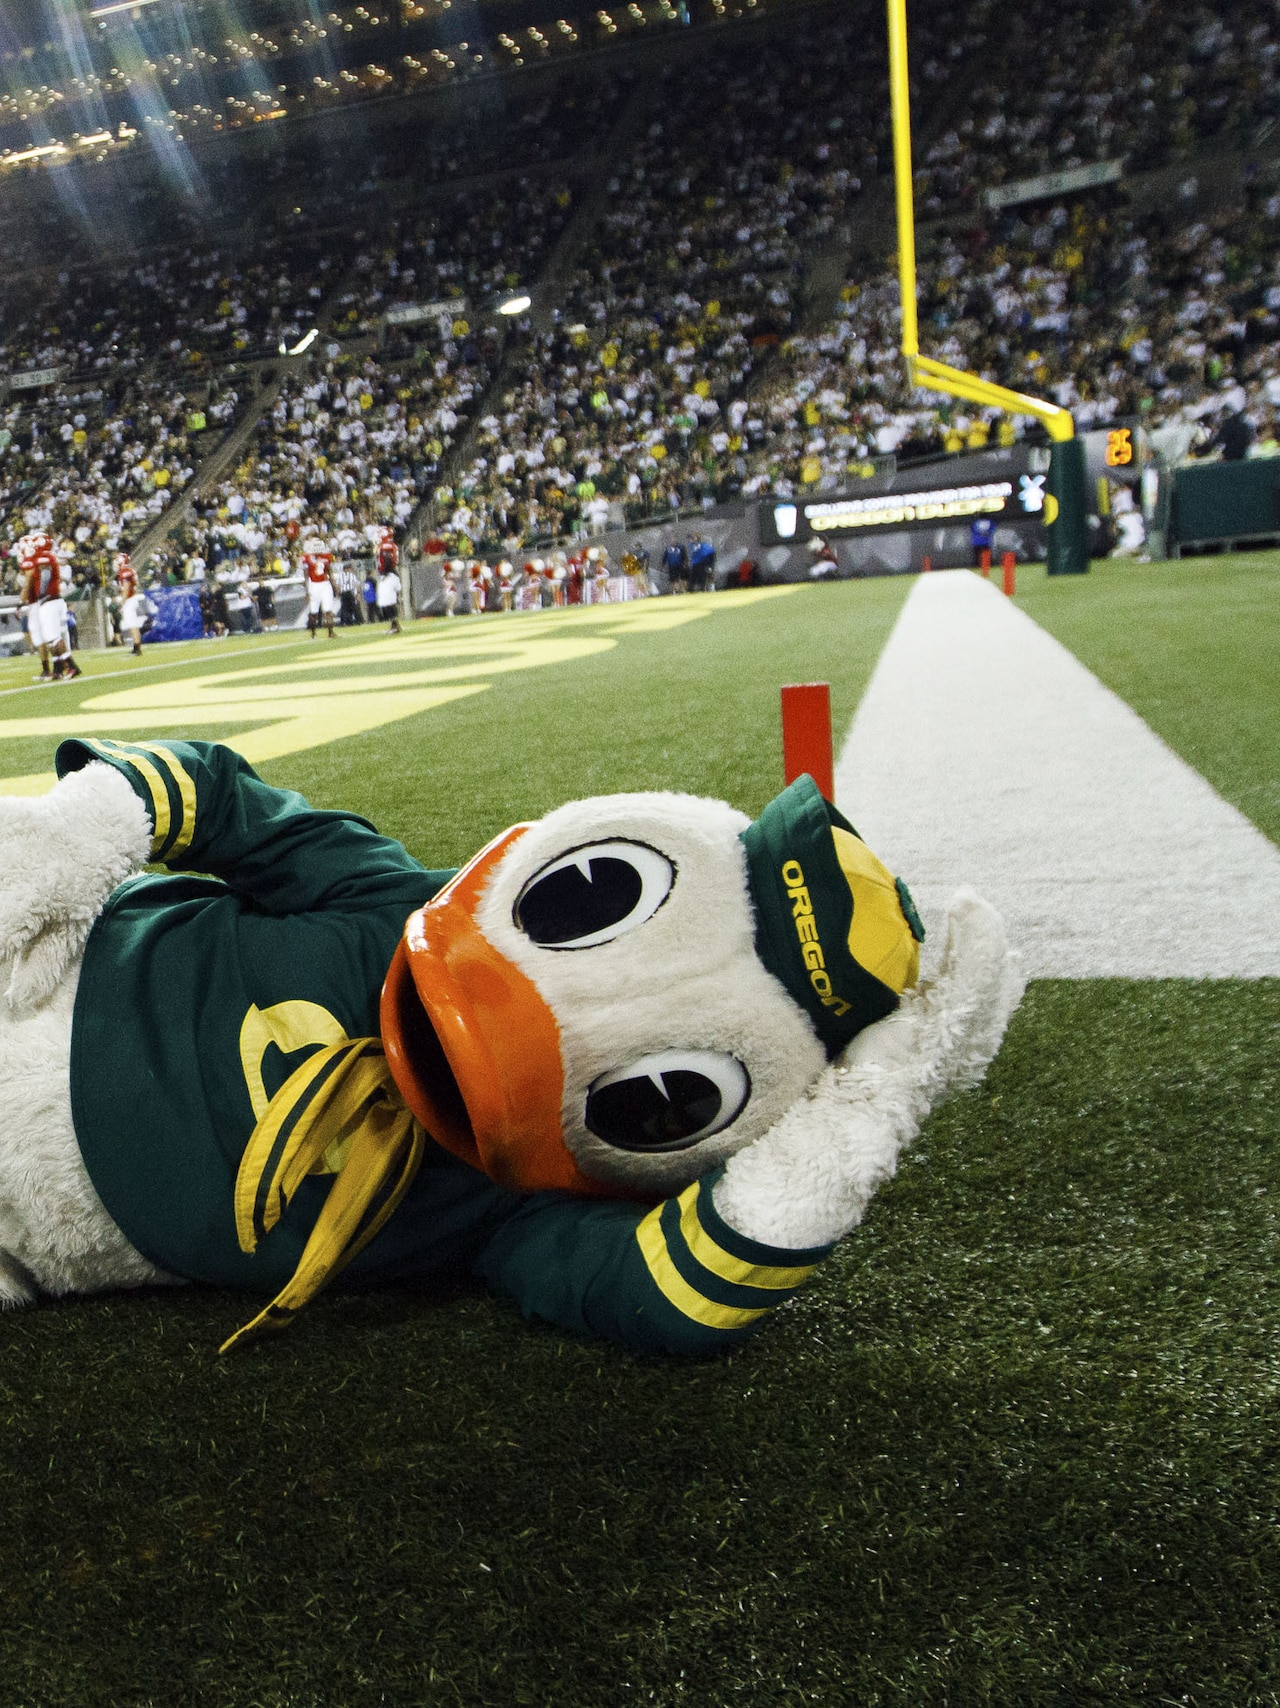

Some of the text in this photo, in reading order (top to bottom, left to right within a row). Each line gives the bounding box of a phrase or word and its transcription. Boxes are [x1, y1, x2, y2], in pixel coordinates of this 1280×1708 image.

[1106, 428, 1132, 466] 25
[804, 482, 1012, 519] EXCLUSIVE COFFEE PROVIDER FOR YOUR
[810, 497, 1005, 531] OREGON DUCKS
[781, 859, 852, 1017] OREGON
